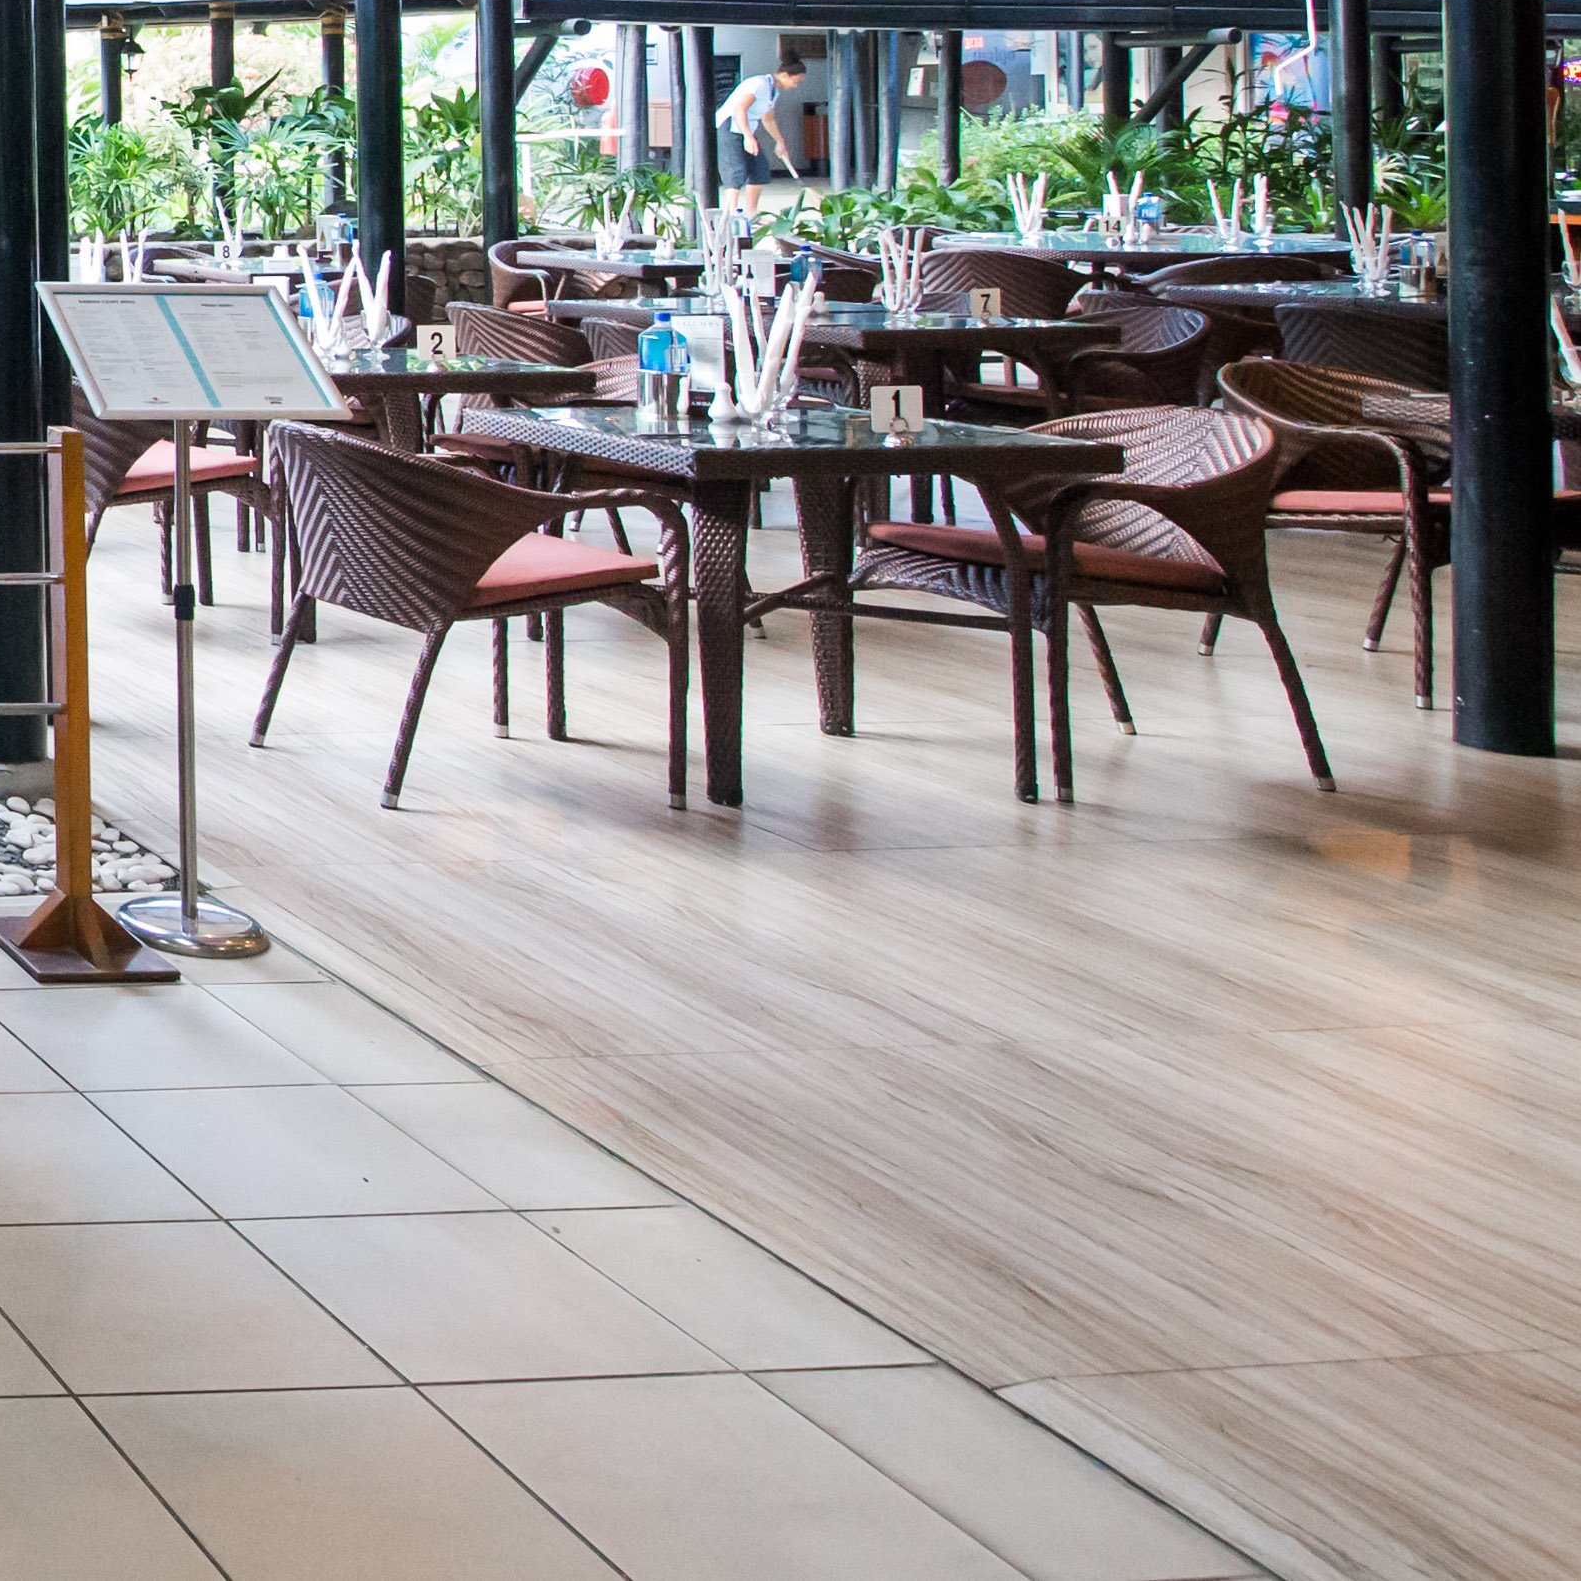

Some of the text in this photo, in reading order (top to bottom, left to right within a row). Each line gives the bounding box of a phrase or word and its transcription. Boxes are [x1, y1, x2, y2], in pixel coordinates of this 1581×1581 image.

[222, 245, 230, 258] 8
[430, 332, 442, 354] 2
[892, 389, 900, 418] 1
